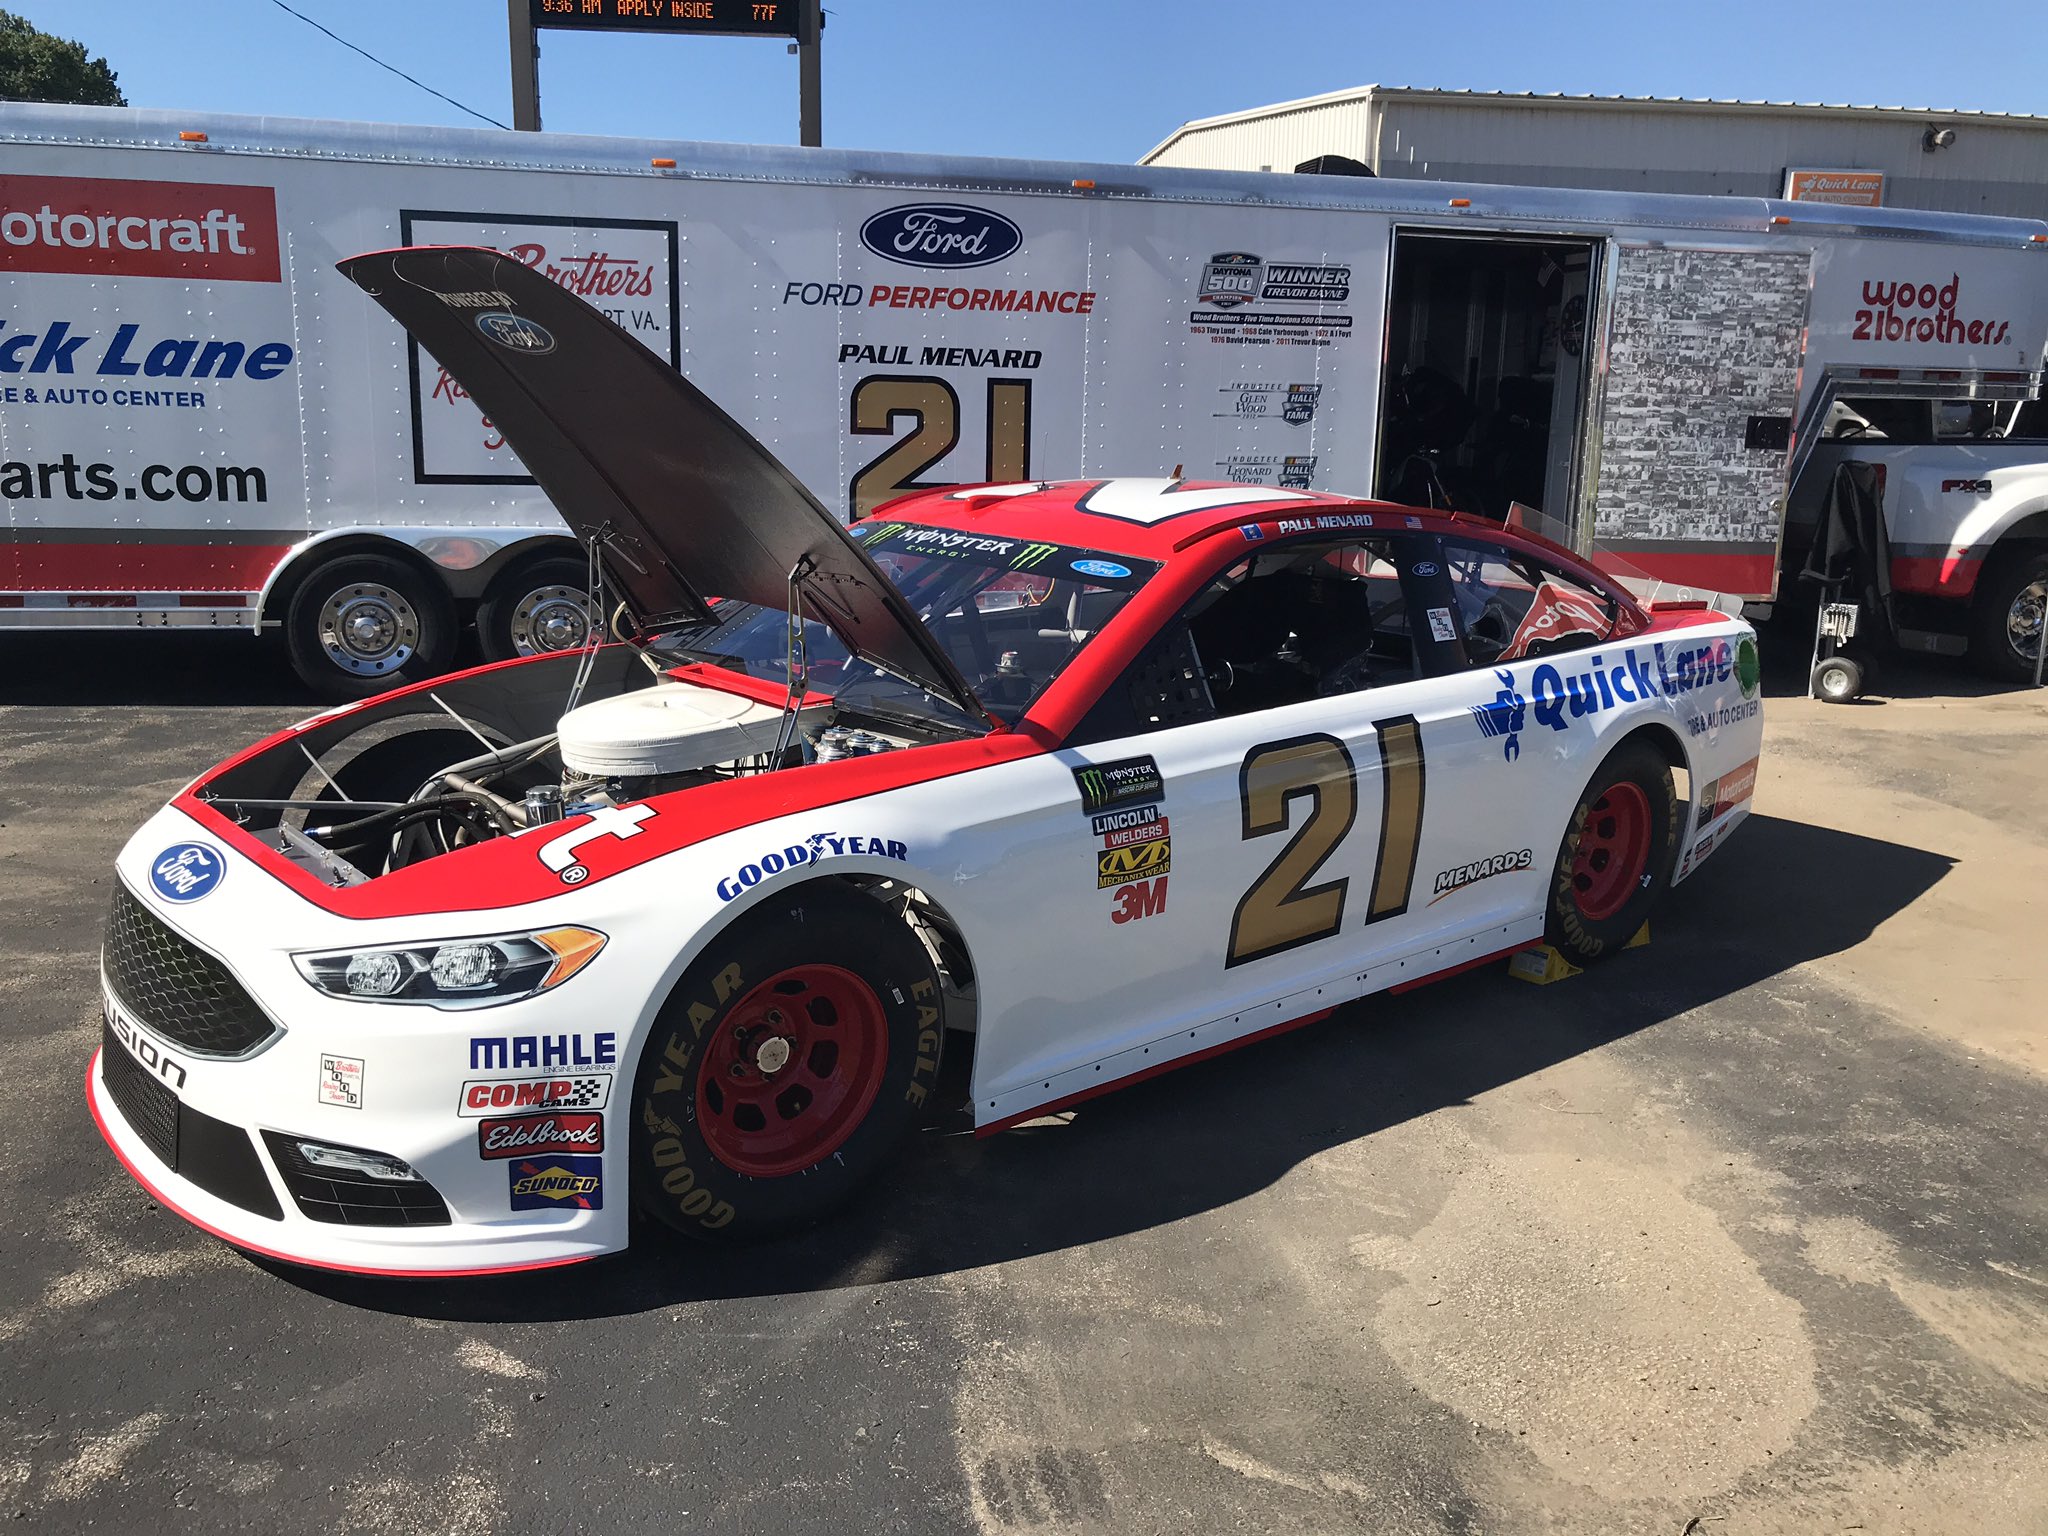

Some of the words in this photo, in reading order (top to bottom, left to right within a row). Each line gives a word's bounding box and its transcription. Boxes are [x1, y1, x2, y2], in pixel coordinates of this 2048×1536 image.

[582, 0, 601, 14] AM
[617, 0, 663, 16] APPLY
[671, 1, 714, 19] INSIDE
[752, 4, 777, 21] 77F
[1817, 178, 1849, 190] Quick
[1851, 179, 1879, 190] Lane
[894, 212, 990, 255] Ford
[1212, 267, 1252, 276] DAYTONA
[1268, 266, 1350, 286] WINNER
[1207, 276, 1254, 291] 500
[1266, 287, 1309, 298] TREVOR
[1308, 289, 1345, 299] BAYNE
[1862, 272, 1960, 311] wood
[783, 282, 863, 306] FORD
[868, 285, 1097, 314] PERFORMANCE
[633, 310, 660, 331] VA.
[1193, 313, 1212, 321] Wood
[1212, 314, 1241, 322] Brothers
[1274, 316, 1301, 324] Daytona
[1314, 317, 1350, 325] Champions
[487, 318, 545, 348] Ford
[1206, 326, 1220, 335] Tiny
[1220, 327, 1236, 335] Lund
[1273, 328, 1309, 337] Yarborough
[1225, 336, 1244, 344] David
[1244, 337, 1271, 345] Pearson
[1291, 338, 1311, 346] Trevor
[98, 323, 294, 380] Lane
[838, 344, 914, 365] PAUL
[920, 346, 1042, 369] MENARD
[1231, 382, 1283, 390] INDUCTEE
[44, 388, 108, 406] AUTO
[112, 390, 206, 408] CENTER
[1290, 394, 1314, 403] HALL
[1285, 411, 1310, 420] FAME
[850, 374, 1033, 519] 21
[1226, 465, 1272, 476] LEONARD
[1286, 466, 1309, 475] HALL
[1278, 517, 1316, 534] PAUL
[1316, 514, 1374, 529] MENARD
[897, 527, 1015, 556] MONSTER
[906, 544, 970, 559] ENERGY
[1531, 649, 1660, 731] Quick
[1654, 638, 1733, 699] Lane
[1707, 709, 1730, 729] AUTO
[1730, 700, 1758, 723] CENTER
[1095, 807, 1156, 832] LINCOLN
[1111, 824, 1162, 845] WELDERS
[1225, 713, 1426, 970] 21
[156, 848, 211, 894] Ford
[1099, 871, 1146, 888] MECHANIX
[1145, 862, 1170, 877] WEAR
[1434, 849, 1533, 895] MENARDS
[1111, 876, 1168, 925] 3M
[470, 1032, 616, 1070] MAHLE
[905, 977, 939, 1110] EAGLE
[543, 1065, 574, 1074] ENGINE
[574, 1064, 616, 1073] BEARINGS
[466, 1080, 572, 1109] COMP
[538, 1097, 591, 1109] CAMS
[484, 1119, 599, 1151] Edelbrock
[516, 1176, 597, 1194] SUNOCO
